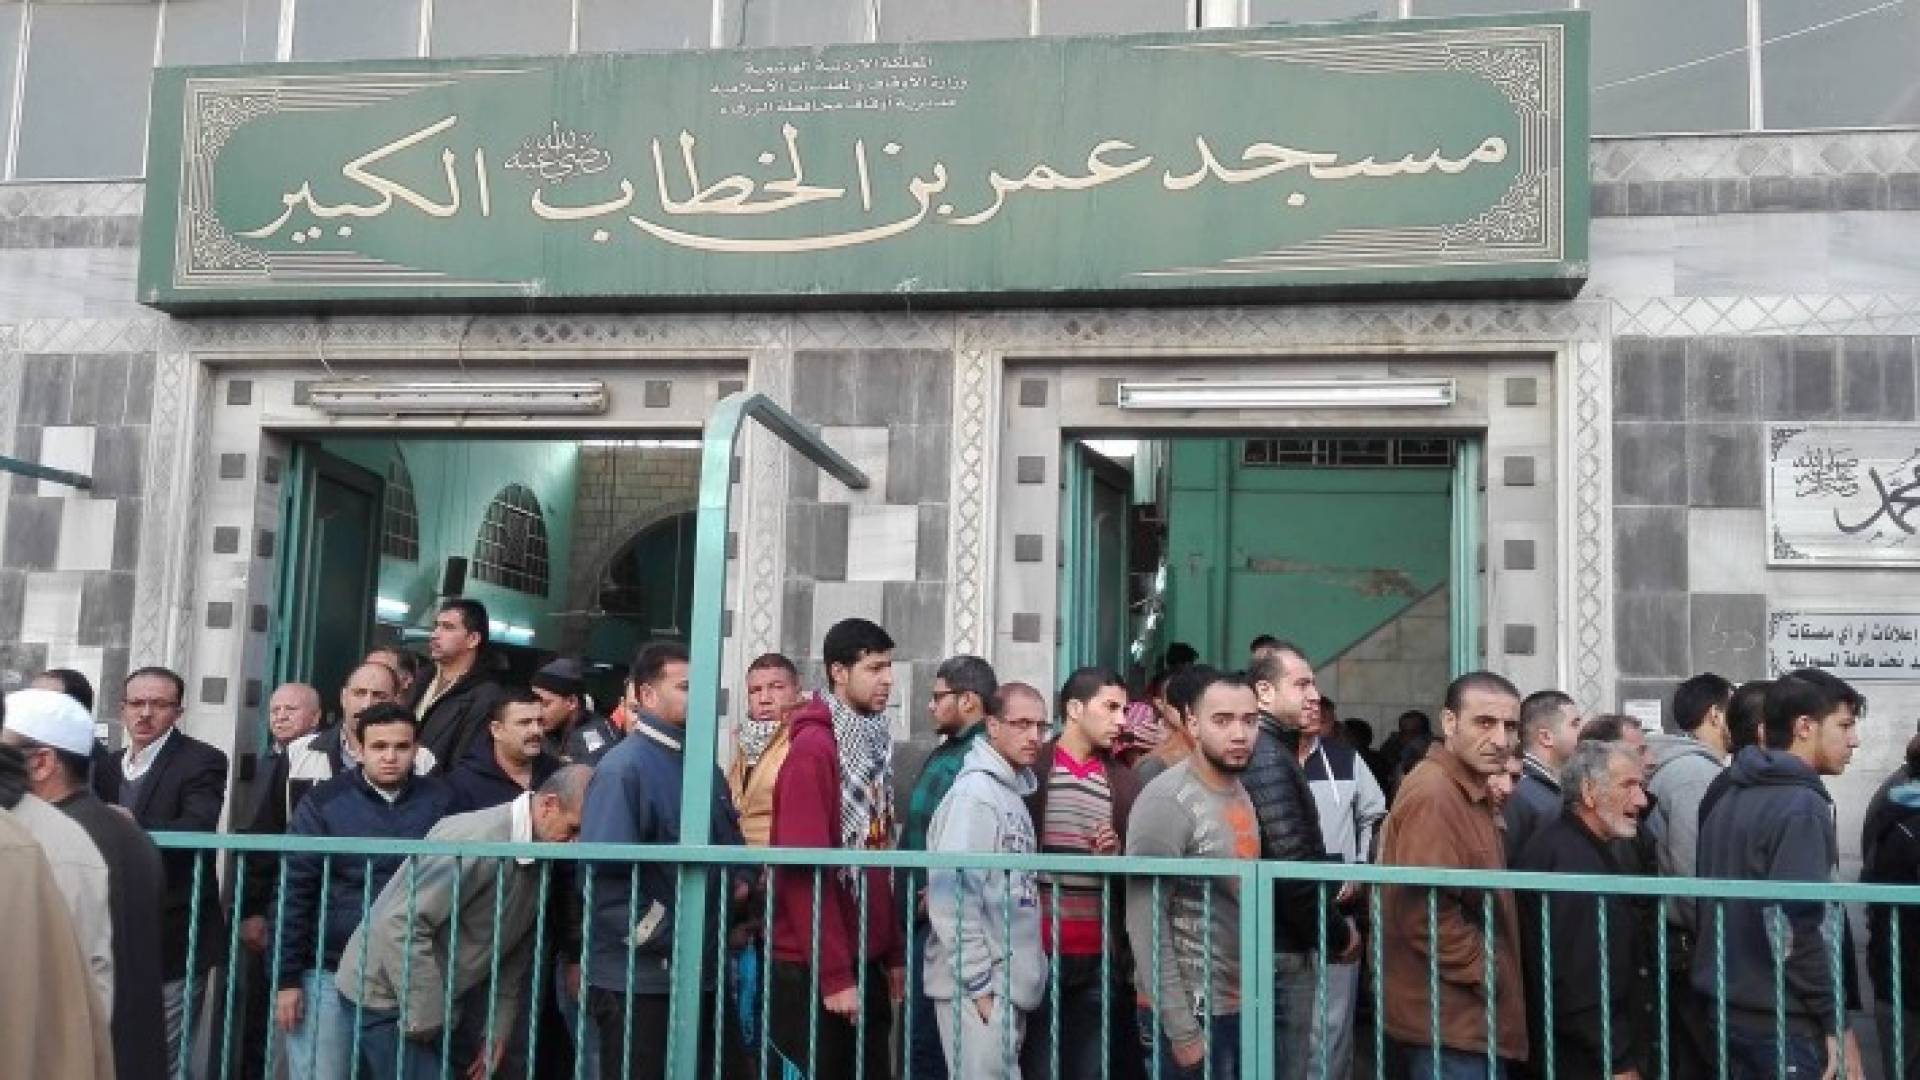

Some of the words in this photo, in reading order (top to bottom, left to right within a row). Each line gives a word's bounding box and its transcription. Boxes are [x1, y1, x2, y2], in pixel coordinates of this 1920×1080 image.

[234, 115, 490, 243] الكبير
[531, 121, 872, 243] الخطاب
[629, 140, 953, 252] بن
[940, 138, 1154, 226] عمر
[1162, 134, 1508, 206] مسجد
